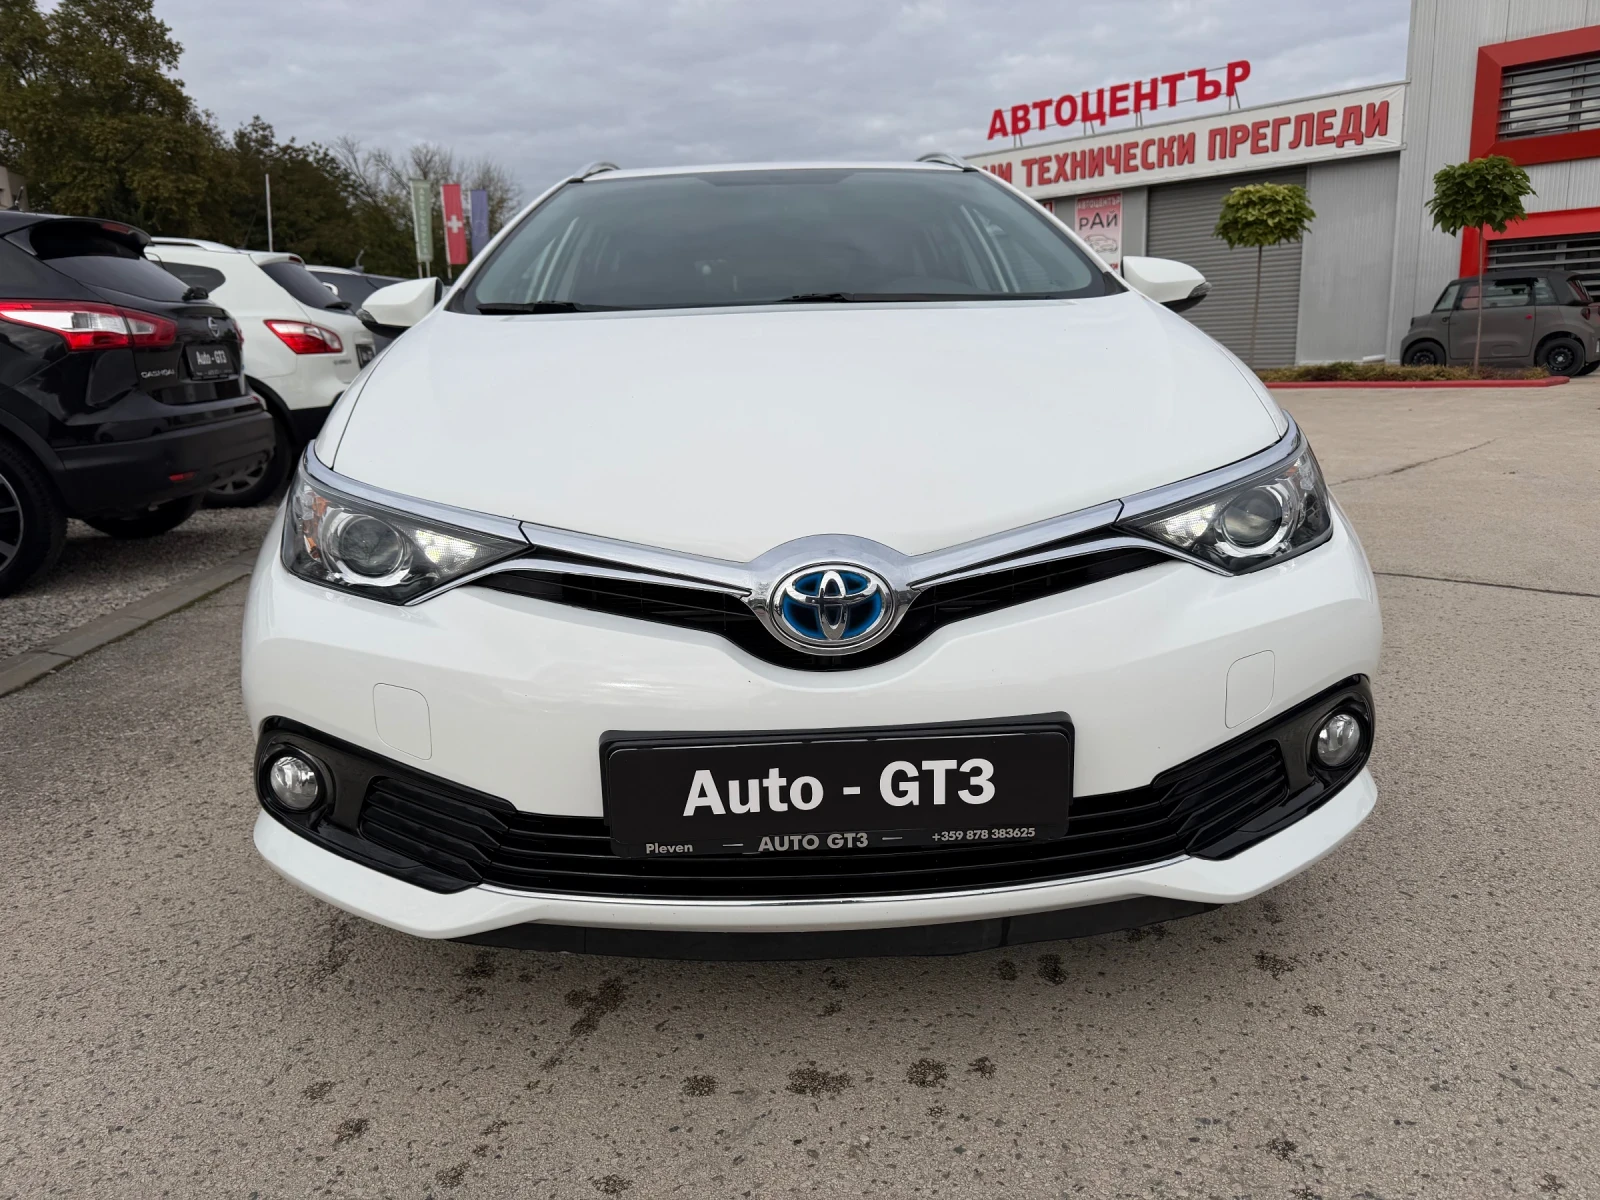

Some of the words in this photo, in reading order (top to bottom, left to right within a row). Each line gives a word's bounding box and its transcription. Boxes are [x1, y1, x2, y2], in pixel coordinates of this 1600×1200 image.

[987, 60, 1251, 140] АВТОЦЕНТЪР
[1021, 132, 1196, 188] ТЕХНИЧЕСКИ
[1208, 100, 1389, 161] ПРЕГЛЕДИ
[196, 351, 211, 365] Auto
[214, 350, 227, 364] GT3
[683, 768, 824, 817] Auto
[880, 758, 996, 807] GT3
[645, 843, 693, 854] Pleven
[758, 835, 820, 851] AUTO
[827, 833, 868, 849] GT3
[932, 830, 964, 842] +359
[966, 829, 989, 840] 878
[991, 828, 1035, 839] 383625
